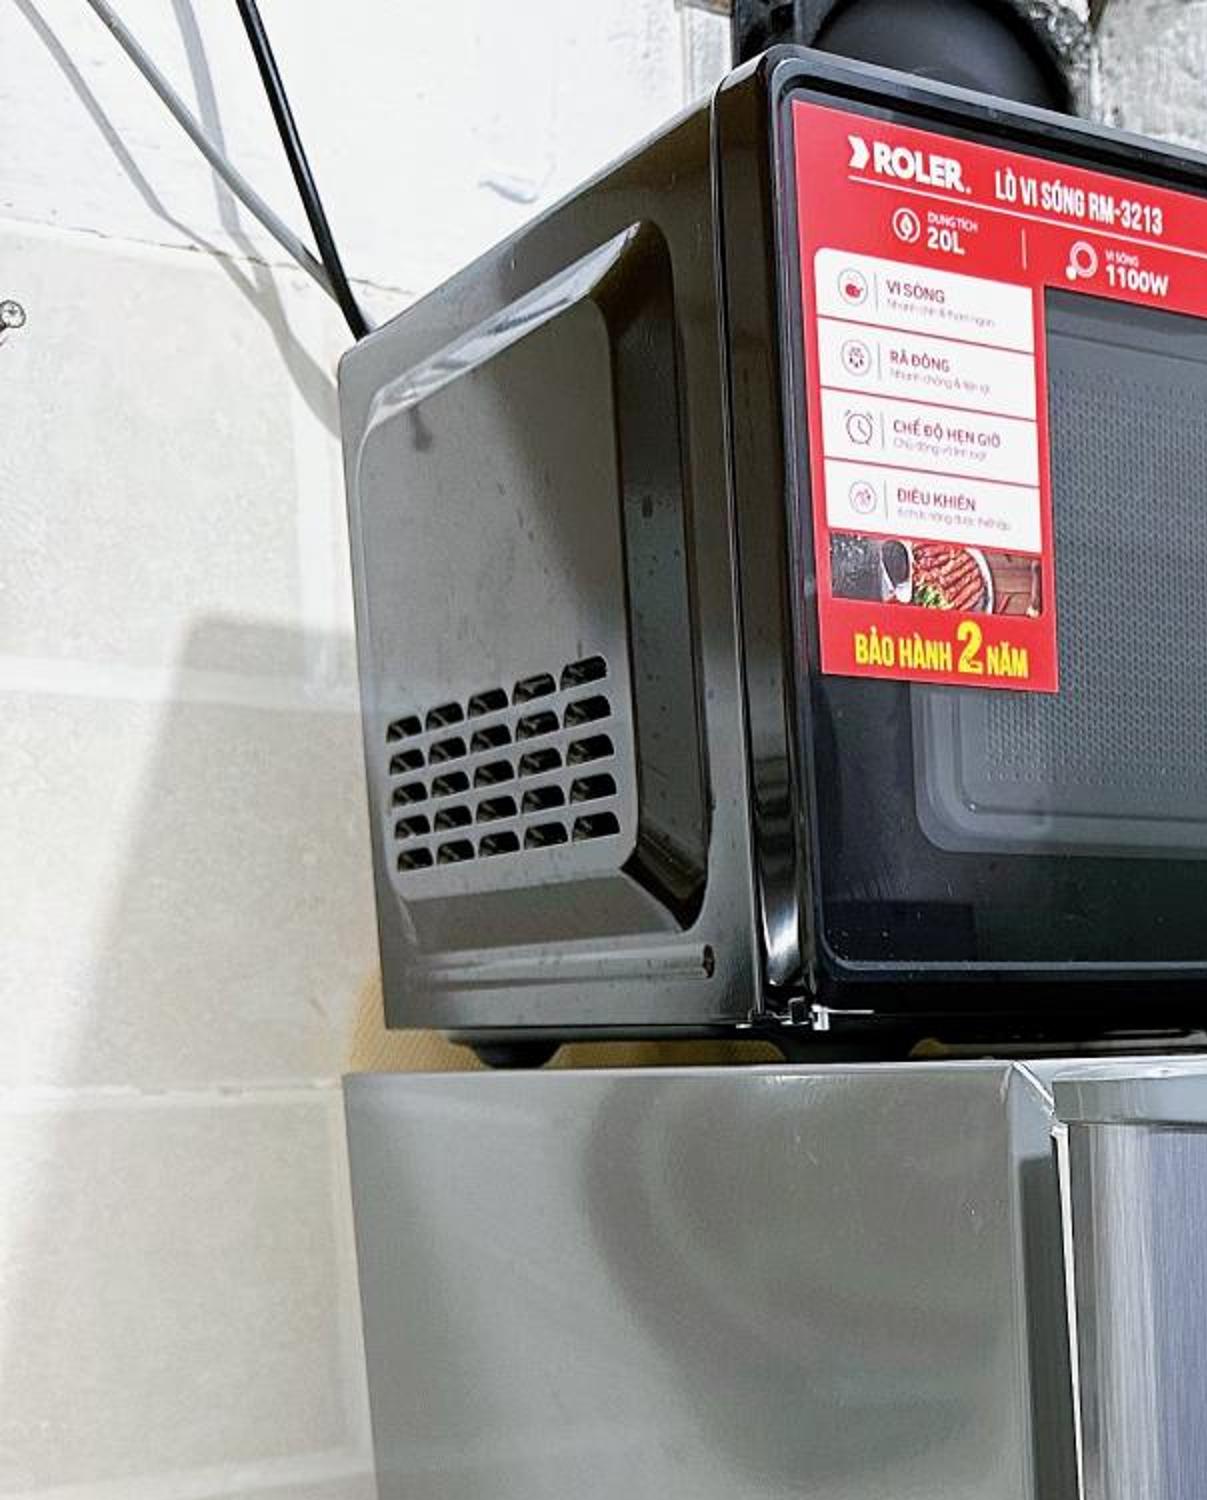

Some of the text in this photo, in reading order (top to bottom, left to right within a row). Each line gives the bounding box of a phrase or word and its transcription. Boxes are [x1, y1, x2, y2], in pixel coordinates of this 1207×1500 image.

[995, 167, 1163, 235] LÒ VI SÓNG RM-3213
[927, 227, 966, 255] 20L
[886, 279, 901, 296] VI
[1105, 265, 1169, 297] 1100W
[854, 620, 1029, 679] BẢO HÀNH 2 NĂM
